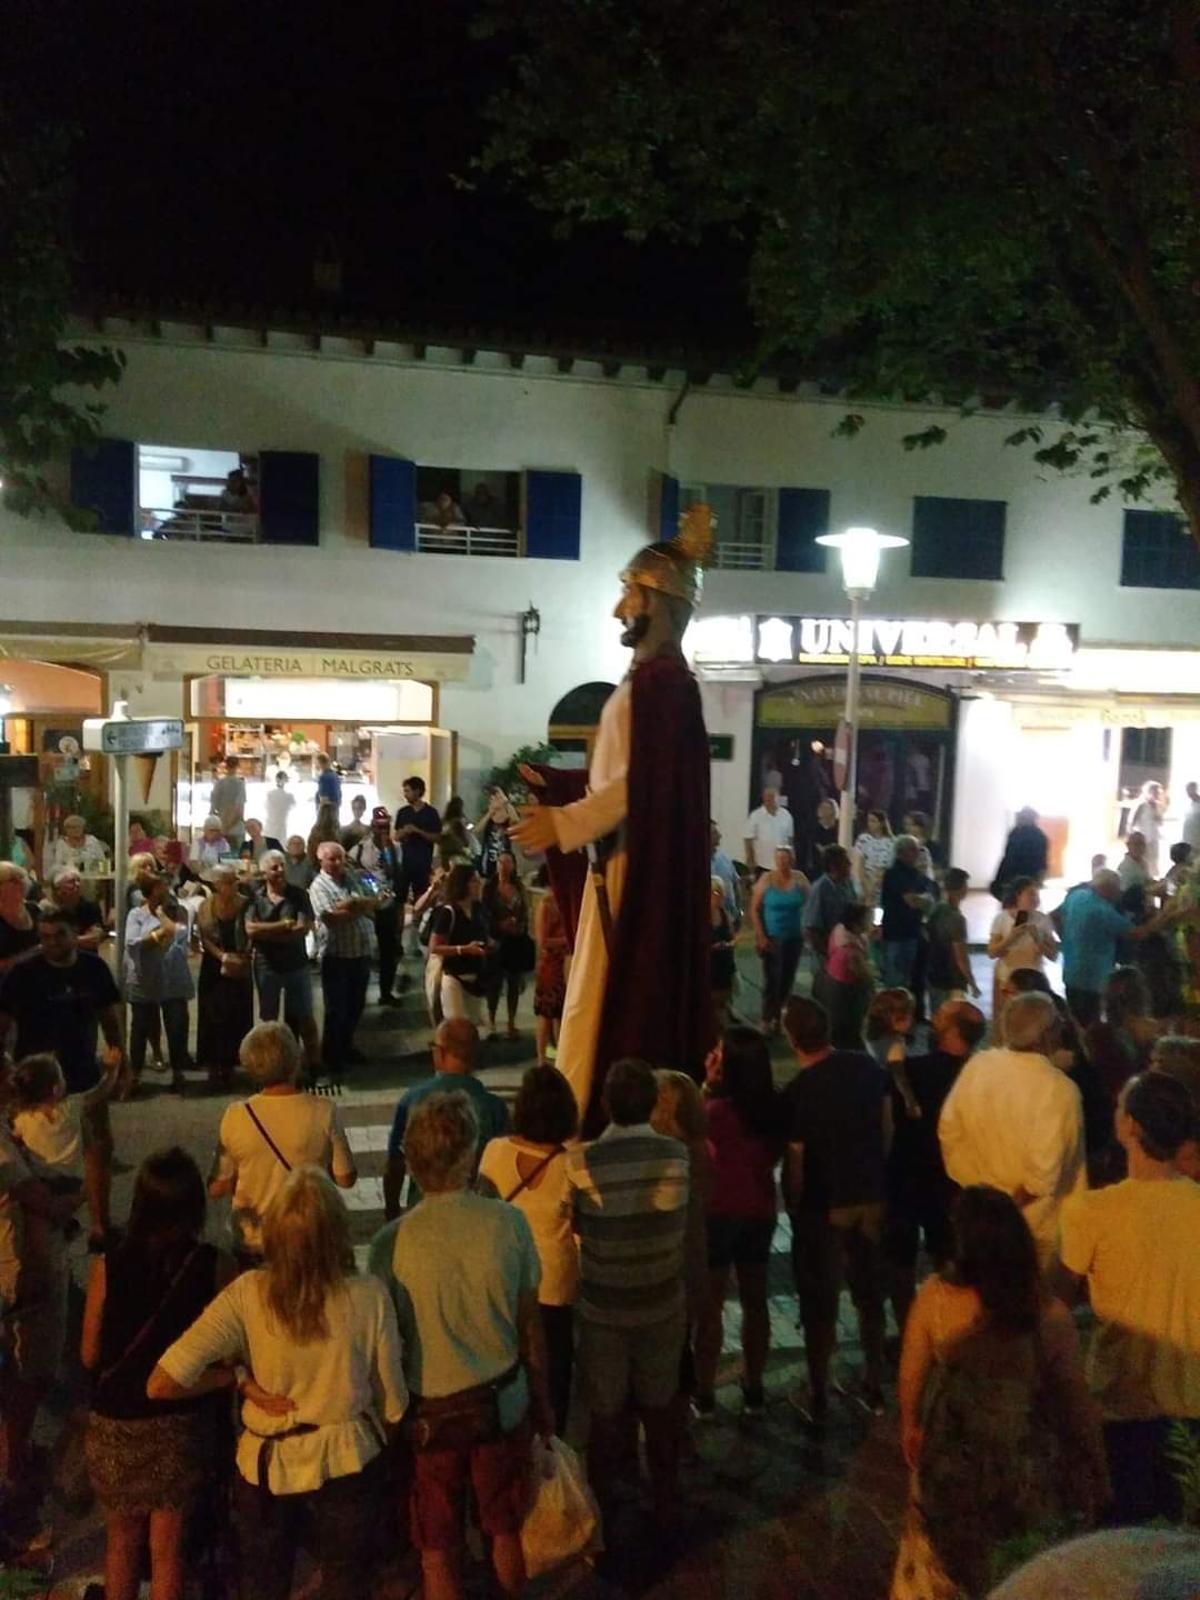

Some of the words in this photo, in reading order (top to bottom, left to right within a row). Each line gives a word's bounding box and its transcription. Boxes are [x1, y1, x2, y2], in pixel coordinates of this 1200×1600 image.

[801, 618, 1028, 663] UNIVERSAL
[206, 655, 303, 673] GELATERIA
[321, 658, 414, 677] MALGRATS
